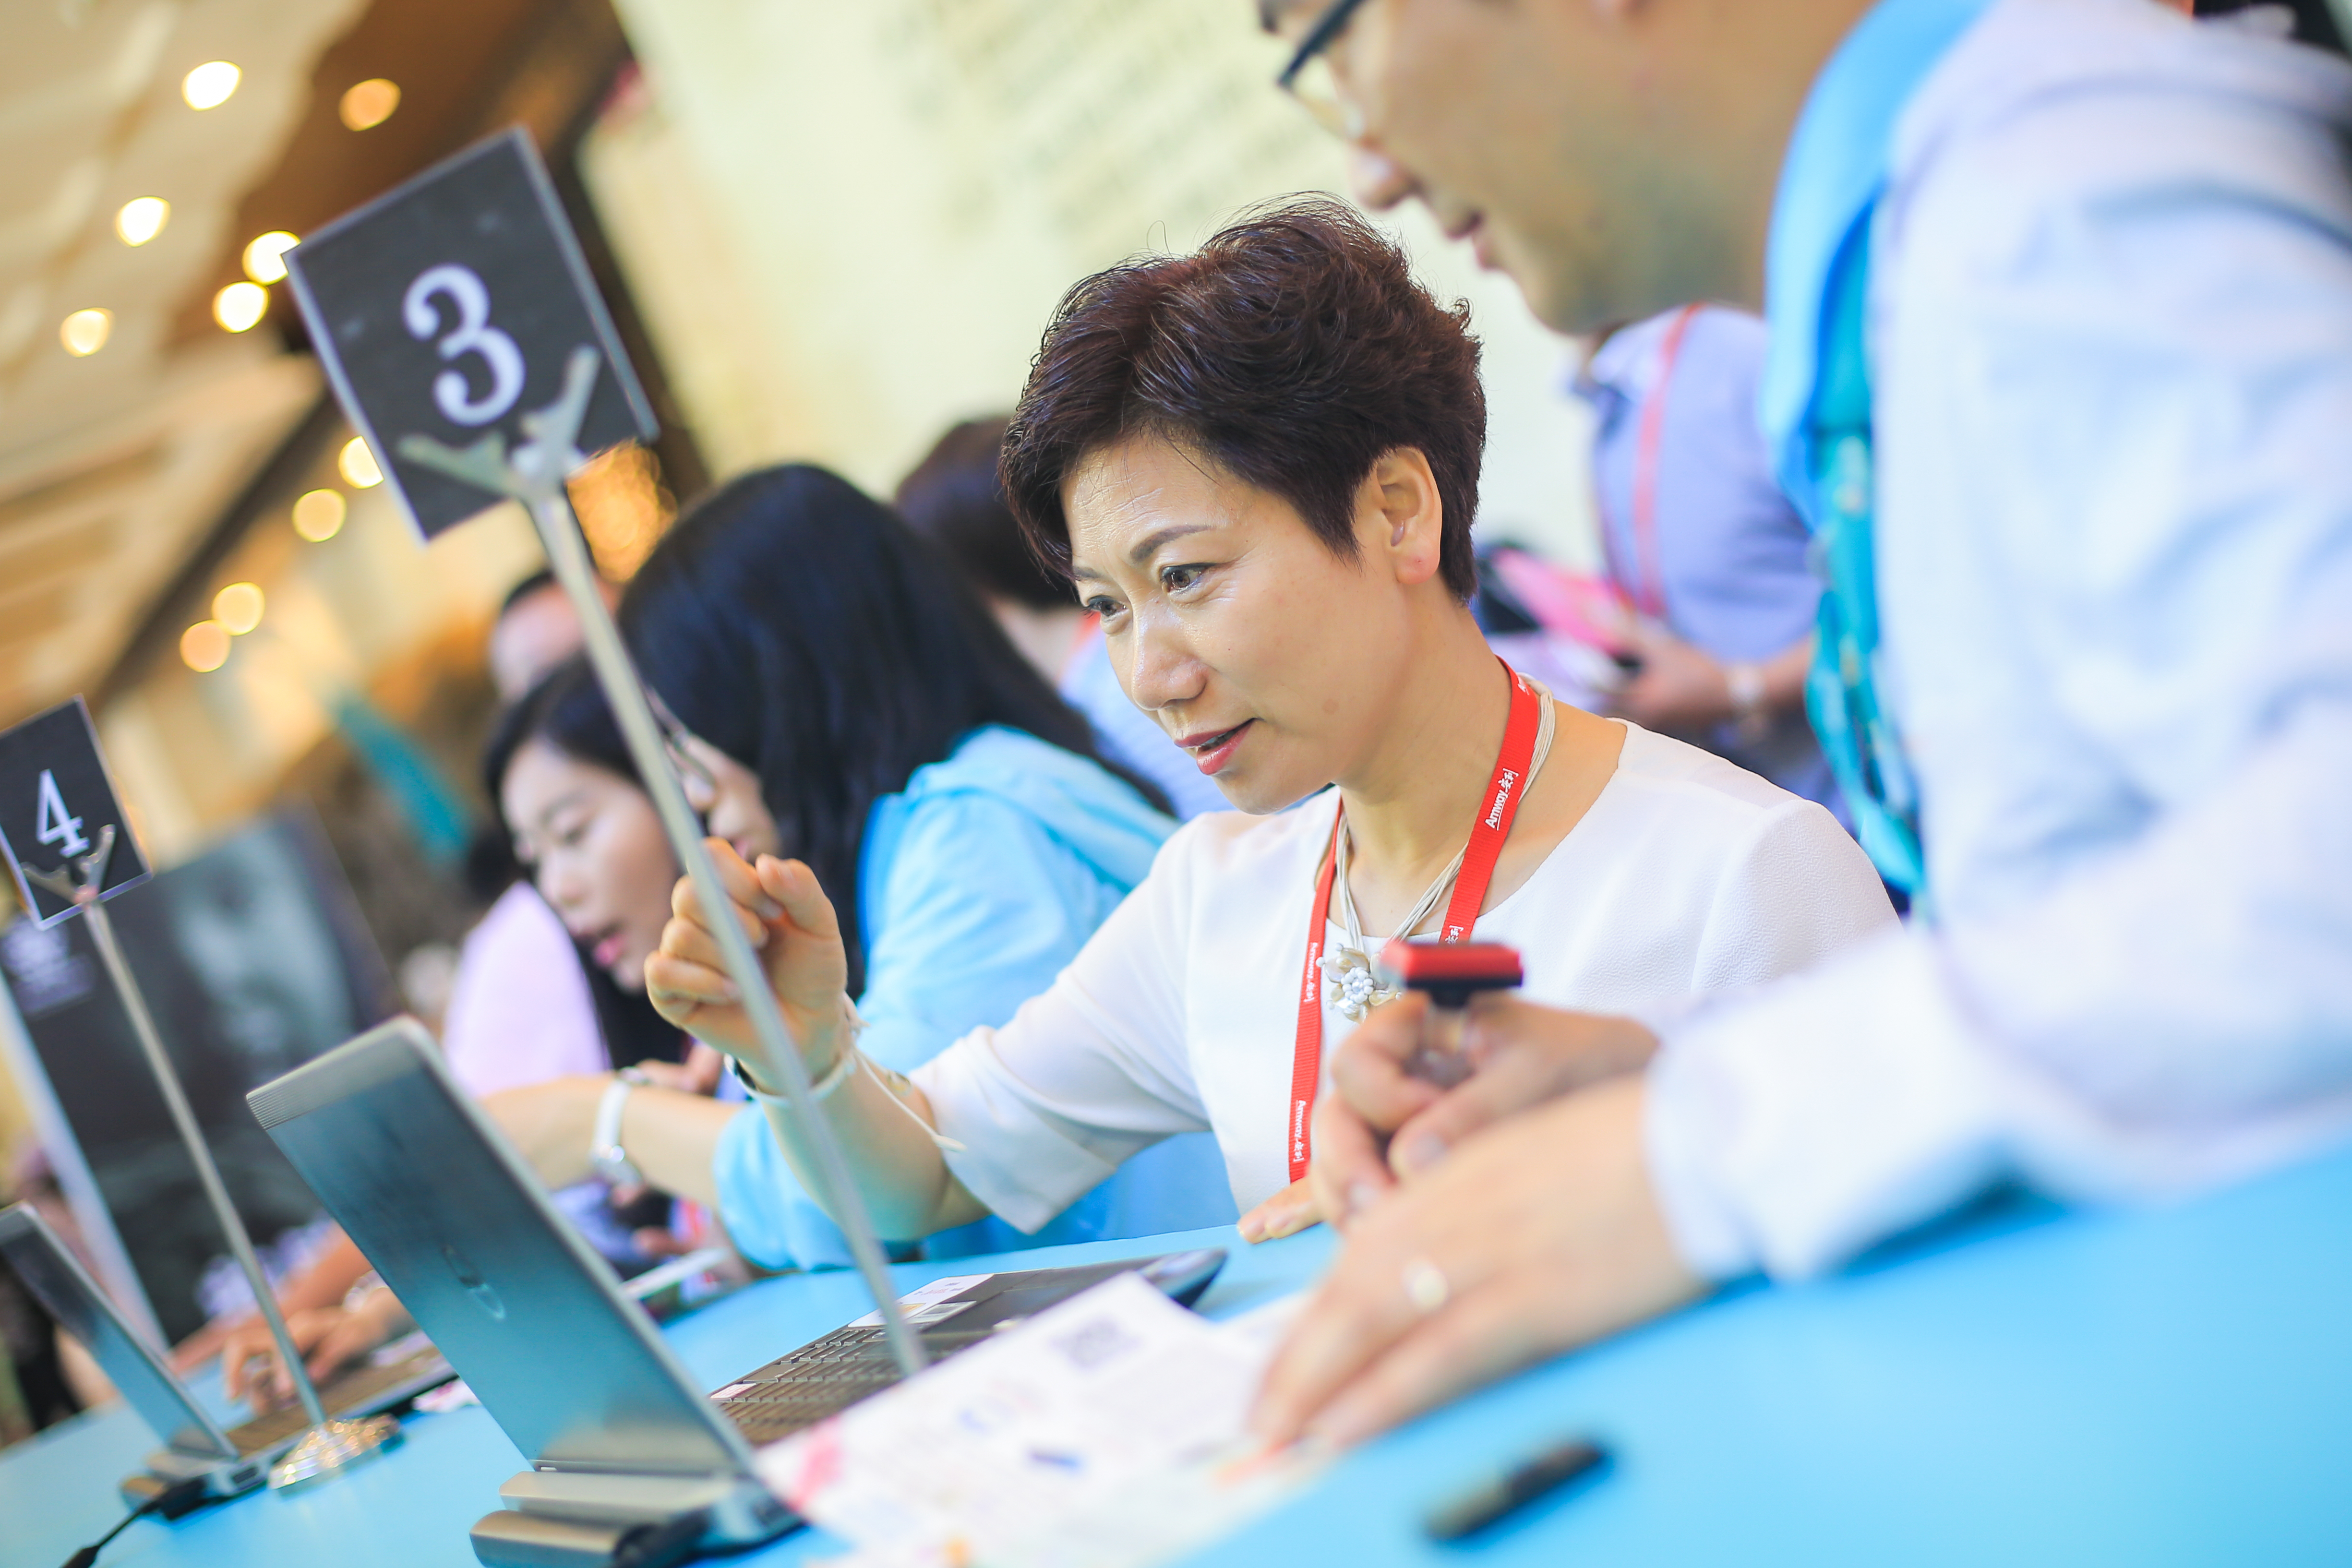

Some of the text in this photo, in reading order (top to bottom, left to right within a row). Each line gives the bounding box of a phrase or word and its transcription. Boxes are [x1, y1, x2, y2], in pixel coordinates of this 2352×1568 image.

[403, 263, 527, 426] 3
[36, 768, 90, 858] 4
[1485, 768, 1519, 830] Amway 安利
[1307, 942, 1318, 979] Amway
[1295, 1100, 1306, 1138] Amway
